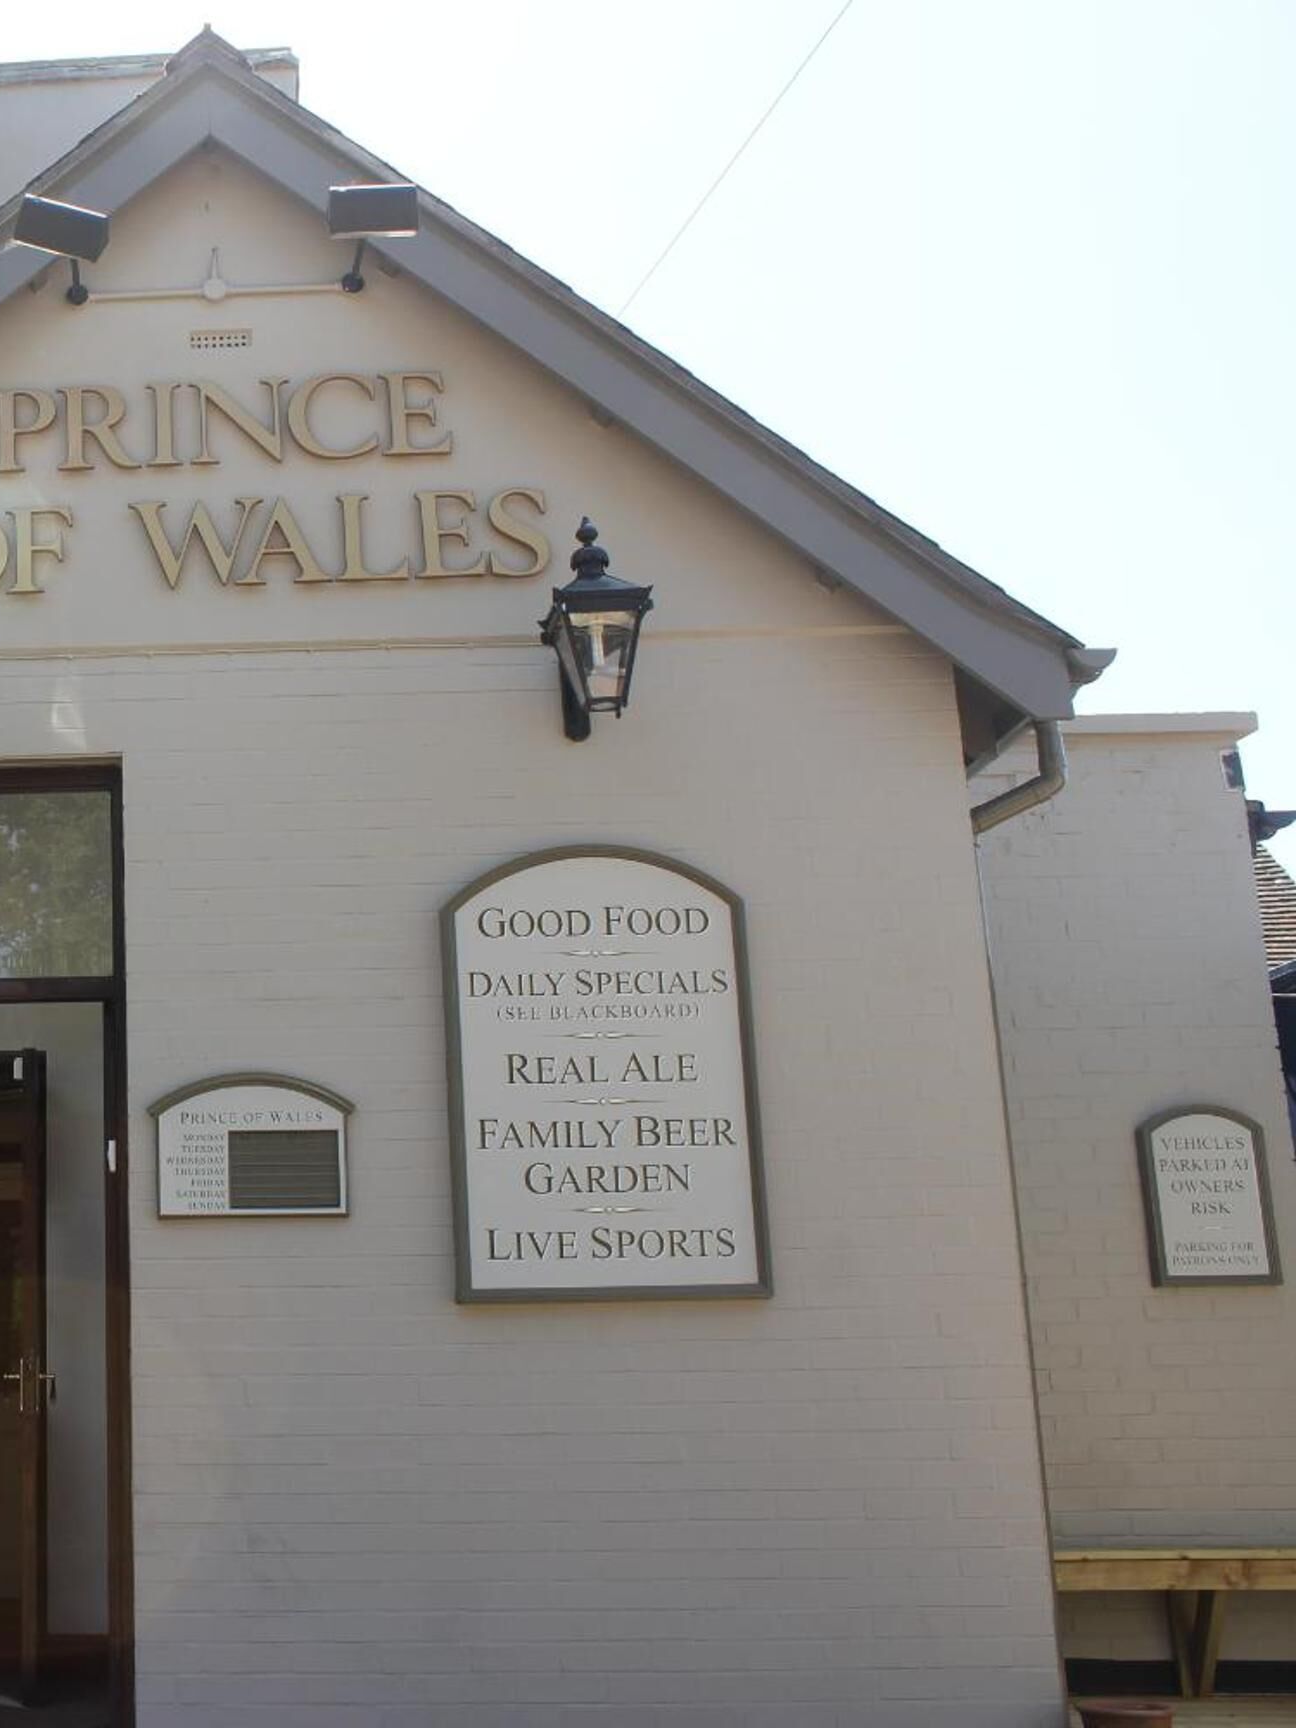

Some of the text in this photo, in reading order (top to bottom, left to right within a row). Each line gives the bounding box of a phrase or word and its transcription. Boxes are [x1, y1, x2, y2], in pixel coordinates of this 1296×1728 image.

[128, 485, 551, 590] WALES
[478, 906, 710, 939] GOOD FOOD
[467, 968, 729, 998] DAILY SPECIALS
[496, 1003, 701, 1021] (SEE BLACKBOARD)
[505, 1052, 699, 1084] REAL ALE
[180, 1110, 323, 1125] PRINCE OF WALES
[477, 1115, 737, 1150] FAMILY BEER
[1161, 1136, 1246, 1151] VEHICLES
[524, 1162, 691, 1195] GARDEN
[1159, 1158, 1250, 1172] PARKED AT
[1170, 1179, 1247, 1194] OWNERS
[1191, 1202, 1232, 1215] RISK
[485, 1226, 737, 1261] LIVE SPORTS
